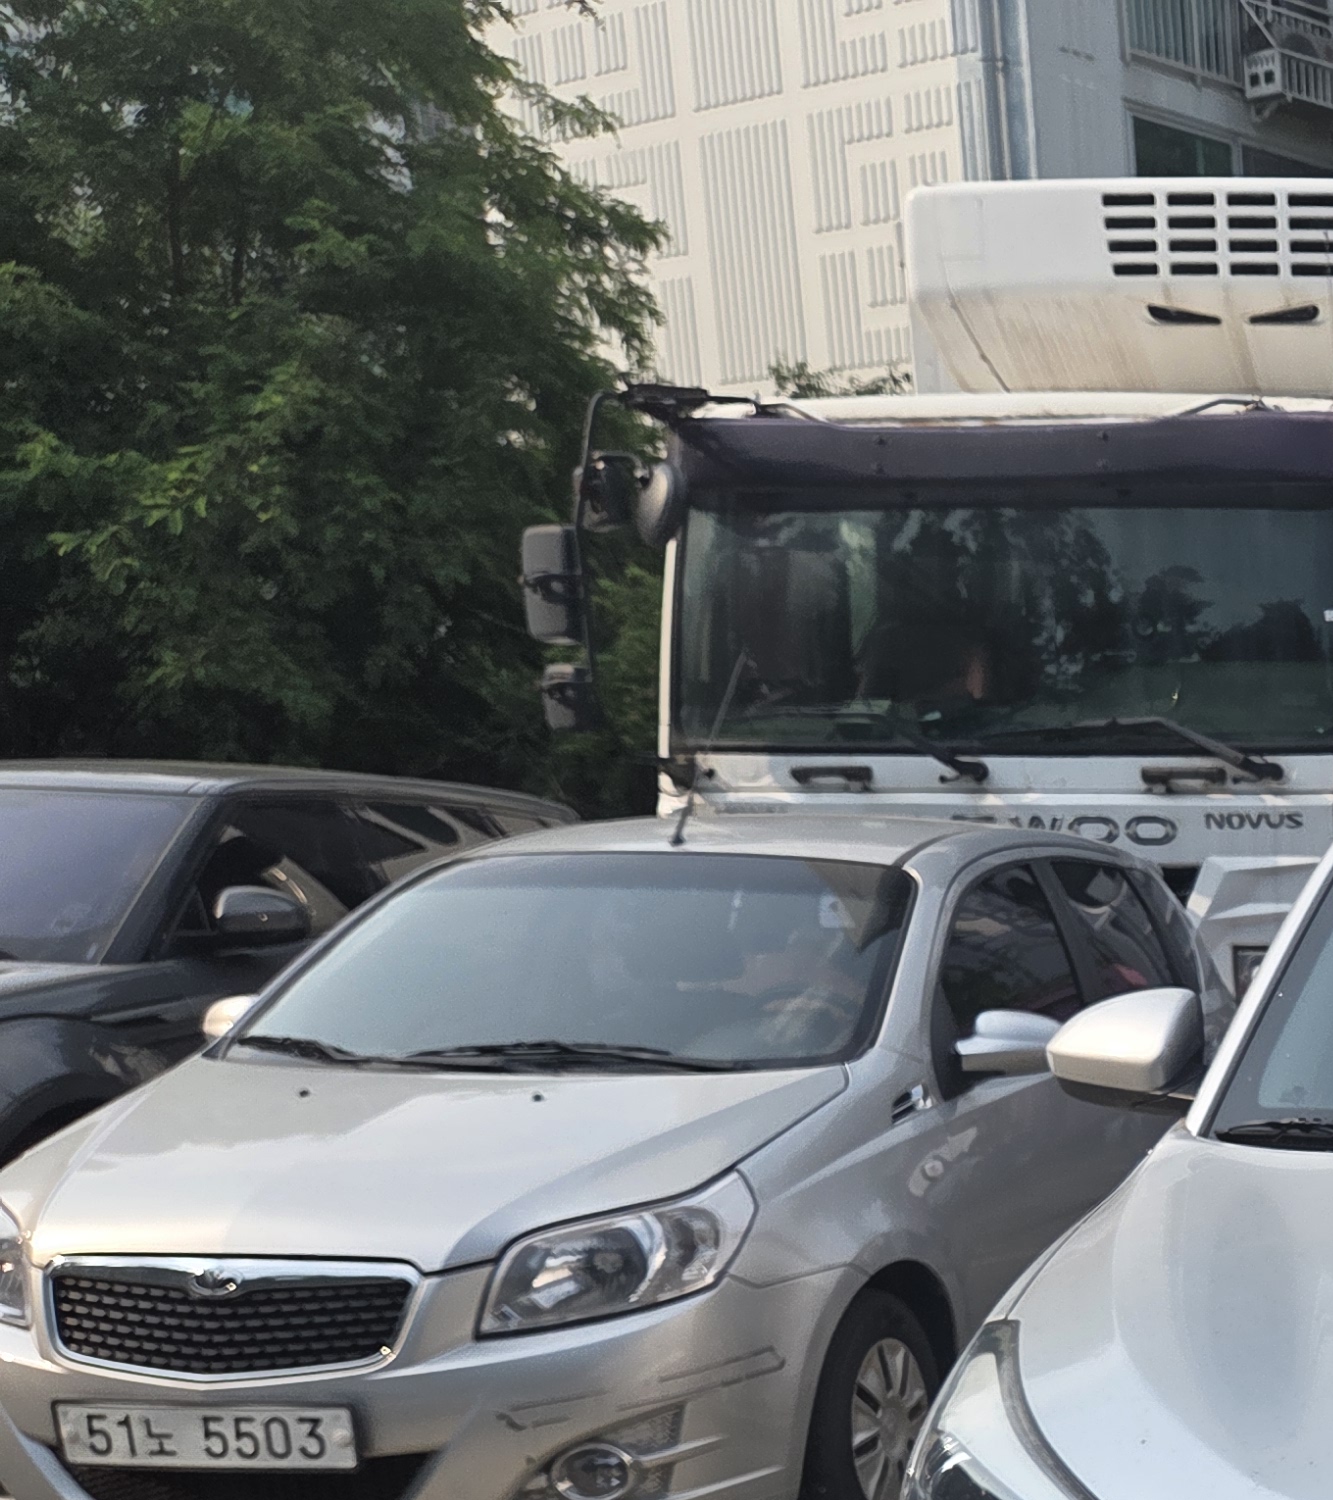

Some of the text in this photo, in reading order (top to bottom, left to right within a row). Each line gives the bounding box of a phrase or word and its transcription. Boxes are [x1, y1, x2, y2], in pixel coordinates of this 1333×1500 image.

[1204, 811, 1304, 831] NOVUS
[85, 1413, 327, 1460] 51노 5503
